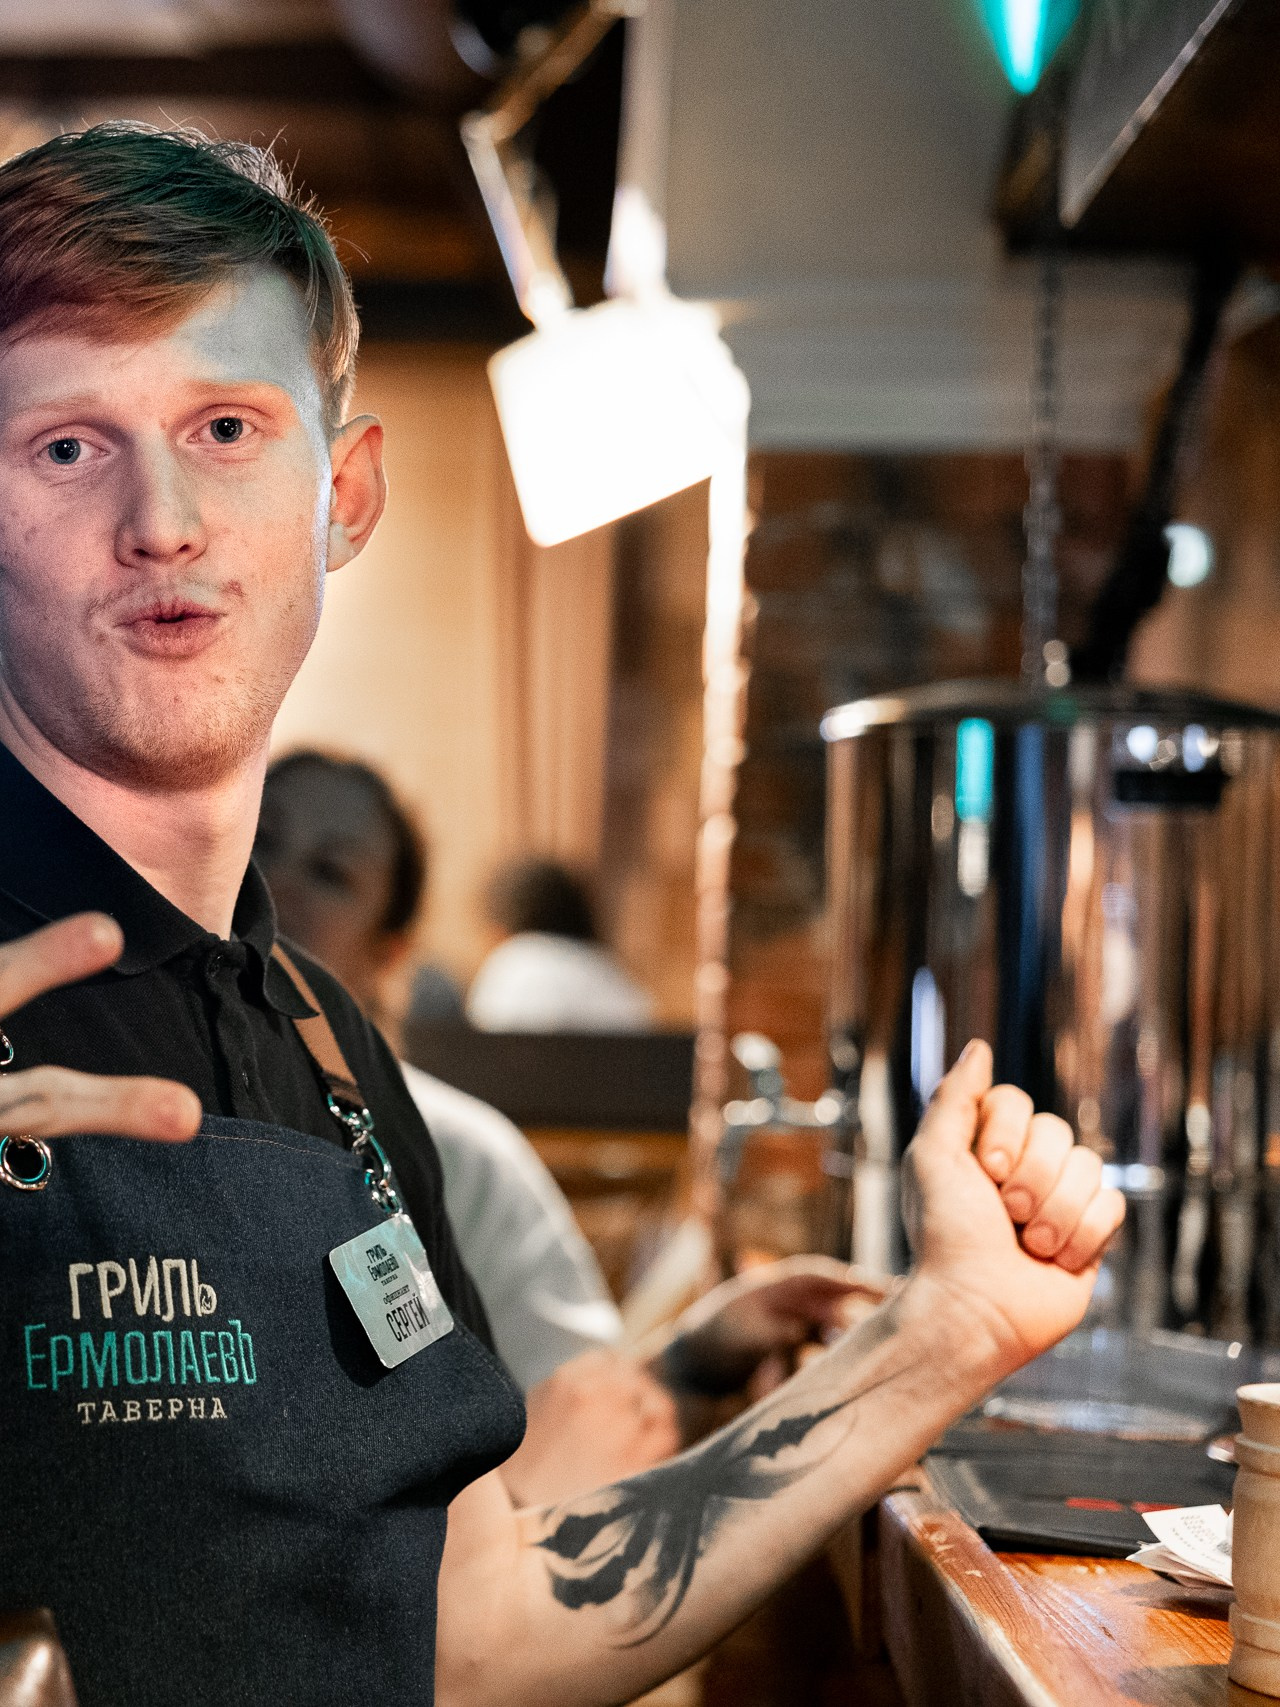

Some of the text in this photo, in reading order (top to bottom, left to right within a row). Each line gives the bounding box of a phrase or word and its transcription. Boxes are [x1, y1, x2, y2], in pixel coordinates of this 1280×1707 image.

[366, 1244, 387, 1264] ГРИЛЬ
[69, 1256, 217, 1322] ГРИЛЬ
[386, 1293, 430, 1342] СЕРГЕЙ
[24, 1319, 257, 1391] ЕРМОЛАЕВЪ
[77, 1397, 228, 1424] ТАВЕРНА
